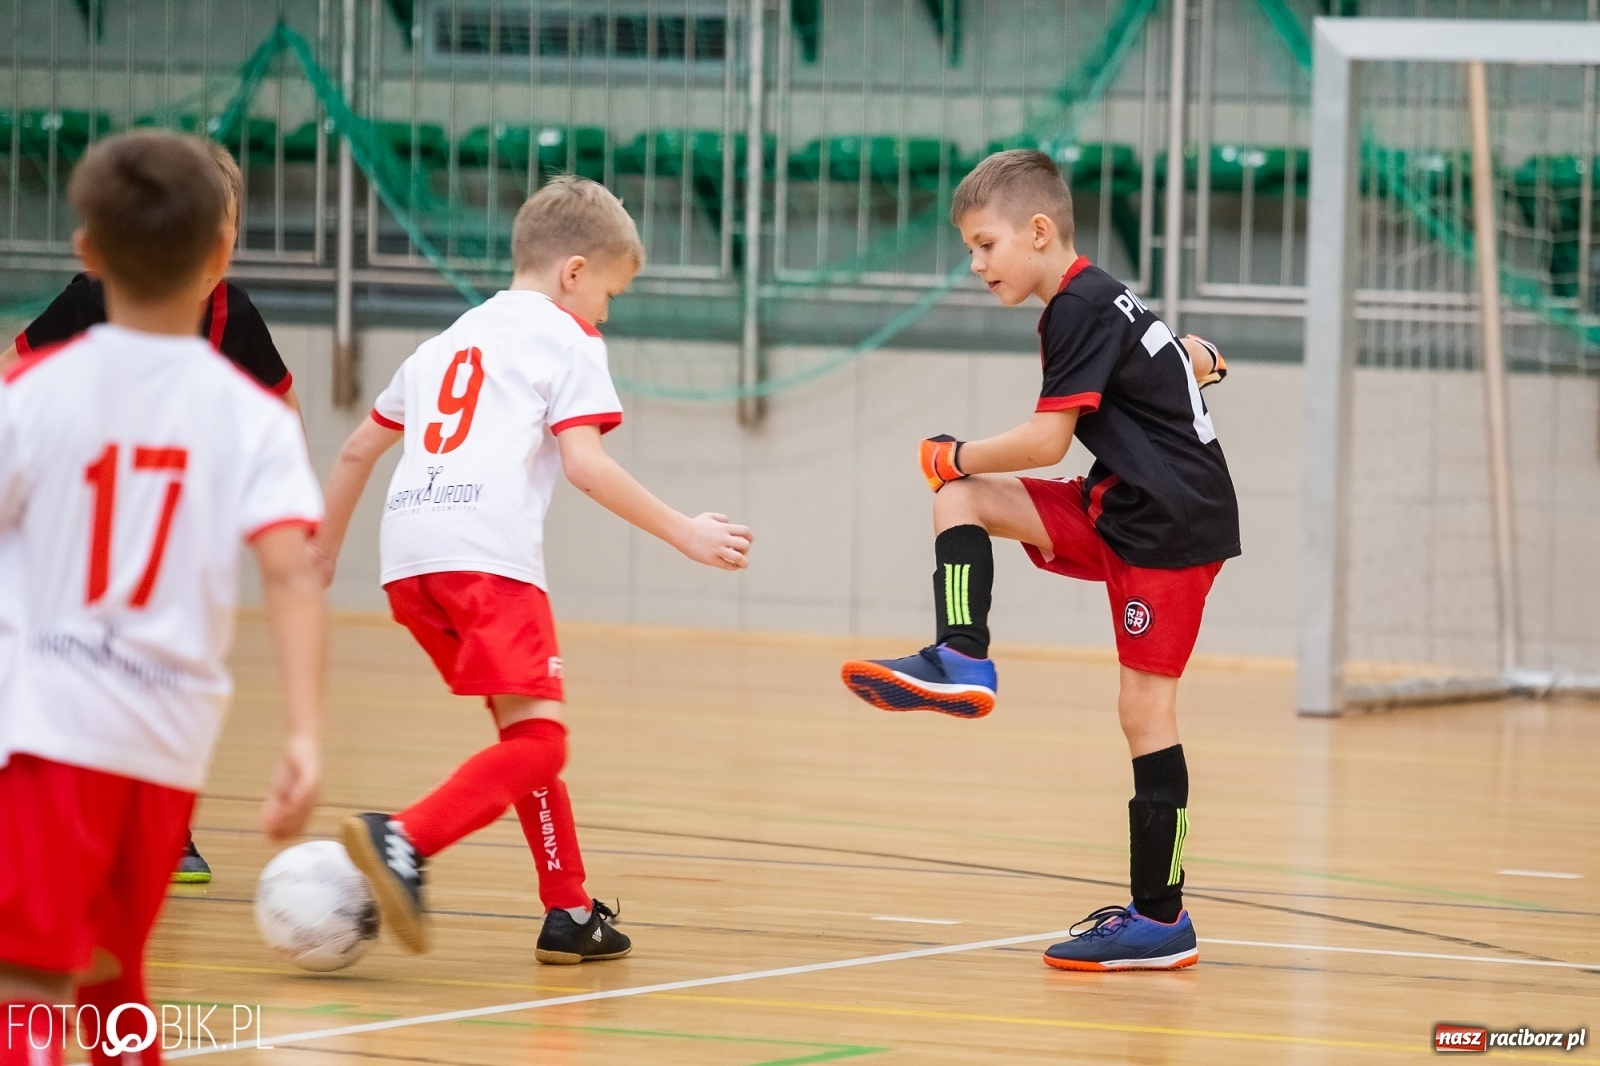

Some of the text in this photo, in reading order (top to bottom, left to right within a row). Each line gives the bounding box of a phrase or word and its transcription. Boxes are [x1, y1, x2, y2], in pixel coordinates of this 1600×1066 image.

[424, 346, 485, 454] 9
[84, 443, 189, 610] 17
[433, 484, 484, 504] URODY
